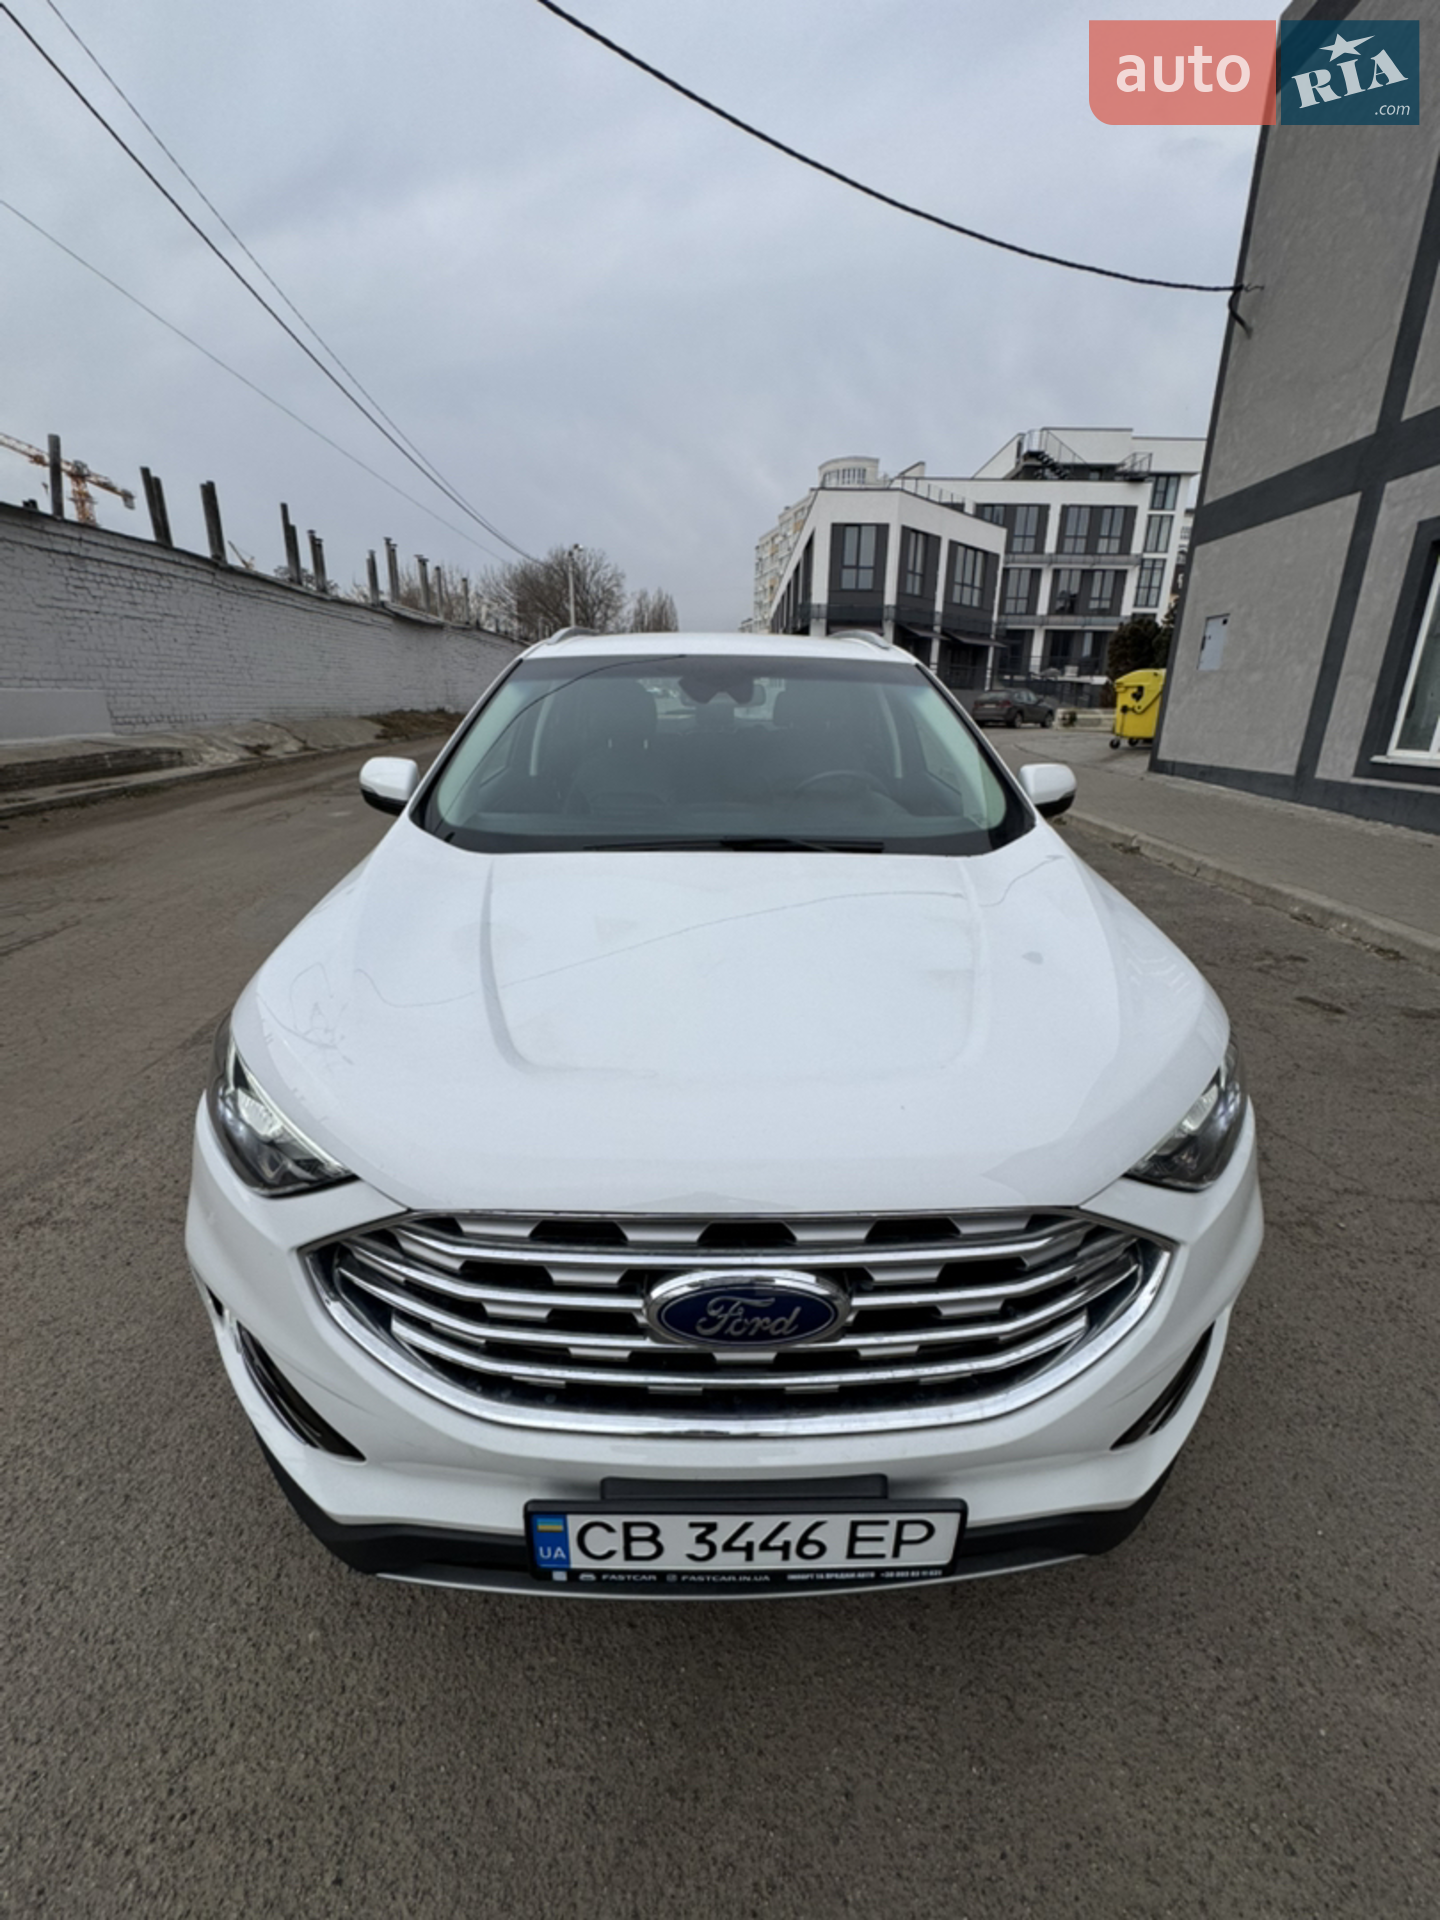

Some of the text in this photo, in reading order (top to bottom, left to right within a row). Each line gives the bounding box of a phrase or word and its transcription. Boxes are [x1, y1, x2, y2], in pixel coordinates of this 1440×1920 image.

[695, 1295, 802, 1337] Ford
[538, 1546, 567, 1560] UA
[576, 1519, 936, 1562] CB 3446 EP
[601, 1573, 658, 1582] FASTCAR
